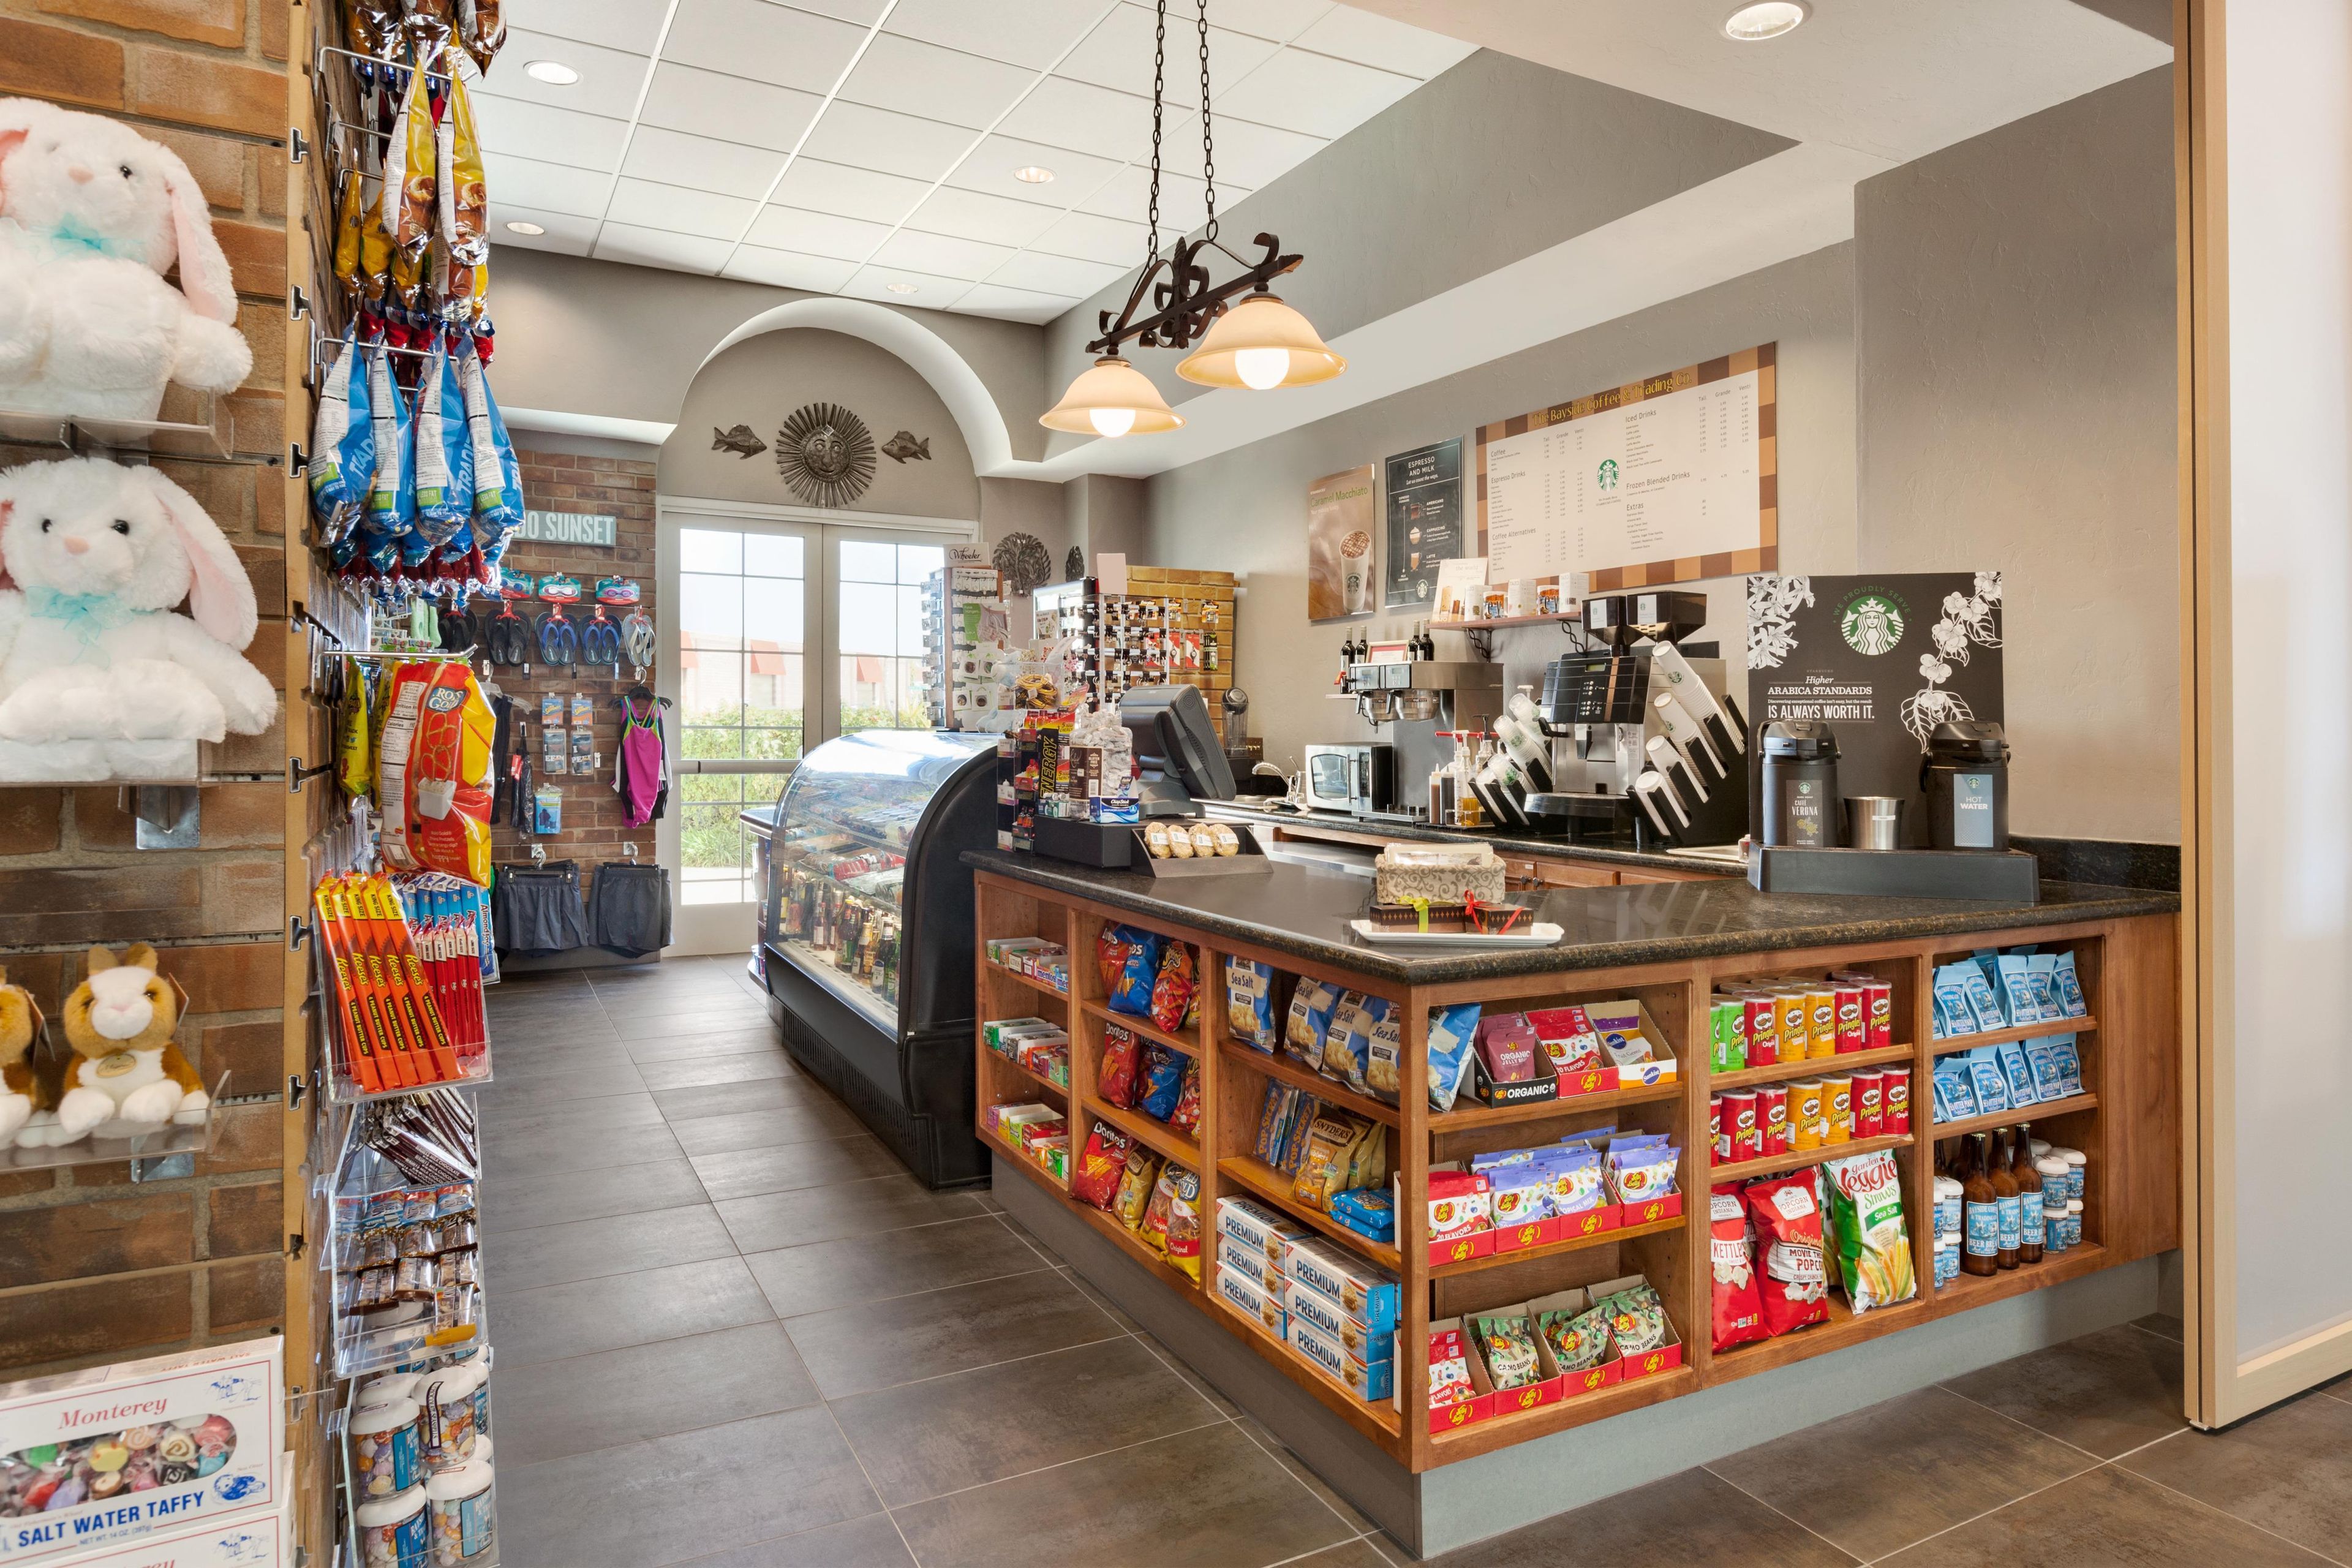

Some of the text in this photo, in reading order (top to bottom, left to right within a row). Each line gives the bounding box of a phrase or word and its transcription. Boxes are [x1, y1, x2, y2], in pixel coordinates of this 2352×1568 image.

[1533, 372, 1692, 426] The Bayside Coffee & Trading Co.
[1638, 409, 1656, 420] Drinks
[1491, 448, 1506, 458] Coffee
[1408, 456, 1435, 469] ESPRESSO
[1409, 468, 1420, 477] AND
[1491, 470, 1526, 484] Espresso Drinks
[1626, 472, 1691, 489] Frozen Blended Drinks
[1310, 492, 1334, 507] Caramel
[1335, 487, 1368, 501] Macchiato
[546, 513, 613, 545] SUNSET
[1508, 528, 1536, 538] Alternatives
[949, 547, 981, 560] Wheeler
[1833, 586, 1911, 616] WE PROUDLY SERVE
[1805, 676, 1834, 685] Higher
[1768, 705, 1875, 718] IS ALWAYS WORTH IT.
[1792, 807, 1818, 816] VERONA
[481, 905, 489, 932] Almond
[336, 957, 352, 991] Reese's
[353, 952, 369, 986] Reese's
[369, 955, 386, 988] Reese's
[386, 954, 404, 987] Reese's
[405, 954, 423, 986] Reese's
[1037, 970, 1056, 982] mentos
[1231, 972, 1254, 989] Sea Salt
[1295, 982, 1313, 999] Sea Salt
[351, 1006, 360, 1023] PEANUT
[356, 1023, 366, 1043] BUTTER
[405, 1001, 415, 1018] PEANUT
[410, 1018, 420, 1037] BUTTER
[1838, 1019, 1860, 1035] Pringles
[1106, 1023, 1129, 1041] Doritos
[1373, 1026, 1387, 1038] Sea
[1753, 1028, 1774, 1046] Pringles
[1784, 1025, 1805, 1042] Pringles
[1812, 1022, 1834, 1039] Pringles
[1608, 1035, 1625, 1046] Sunkist
[1501, 1050, 1530, 1060] ORGANIC
[1564, 1060, 1585, 1072] FLAVORS
[1643, 1068, 1660, 1084] Sunkist
[1507, 1085, 1549, 1099] ORGANIC
[1887, 1099, 1908, 1116] Pringles
[1094, 1121, 1126, 1149] Doritos
[430, 1153, 460, 1176] MILK CHOCOLATE
[1852, 1157, 1879, 1175] garden
[1831, 1157, 1897, 1200] Veggie
[1780, 1197, 1808, 1210] POPCORN
[1864, 1185, 1897, 1209] Straws
[1234, 1200, 1281, 1225] PREMIUM
[1787, 1205, 1806, 1214] INDIANA
[1875, 1207, 1898, 1221] Sea Salt
[1226, 1216, 1264, 1250] PREMIUM
[1445, 1225, 1471, 1240] FLAVORS
[1524, 1226, 1535, 1236] Jelly
[1170, 1243, 1188, 1254] Original
[1227, 1246, 1262, 1281] PREMIUM
[1297, 1260, 1340, 1299] PREMIUM
[1224, 1279, 1261, 1315] PREMIUM
[1295, 1295, 1339, 1336] PREMIUM
[1370, 1332, 1393, 1343] PREMIUM
[1642, 1335, 1656, 1348] BEANS
[1298, 1330, 1341, 1373] PREMIUM
[1650, 1354, 1660, 1363] Jelly
[1516, 1359, 1531, 1370] BEANS
[1577, 1354, 1594, 1367] BEANS
[57, 1396, 169, 1430] Monterey
[19, 1490, 205, 1547] SALT WATER TAFFY
[79, 1537, 94, 1545] NET
[96, 1534, 107, 1544] WT.
[119, 1531, 130, 1539] OZ.
[132, 1524, 153, 1536] (397g)
